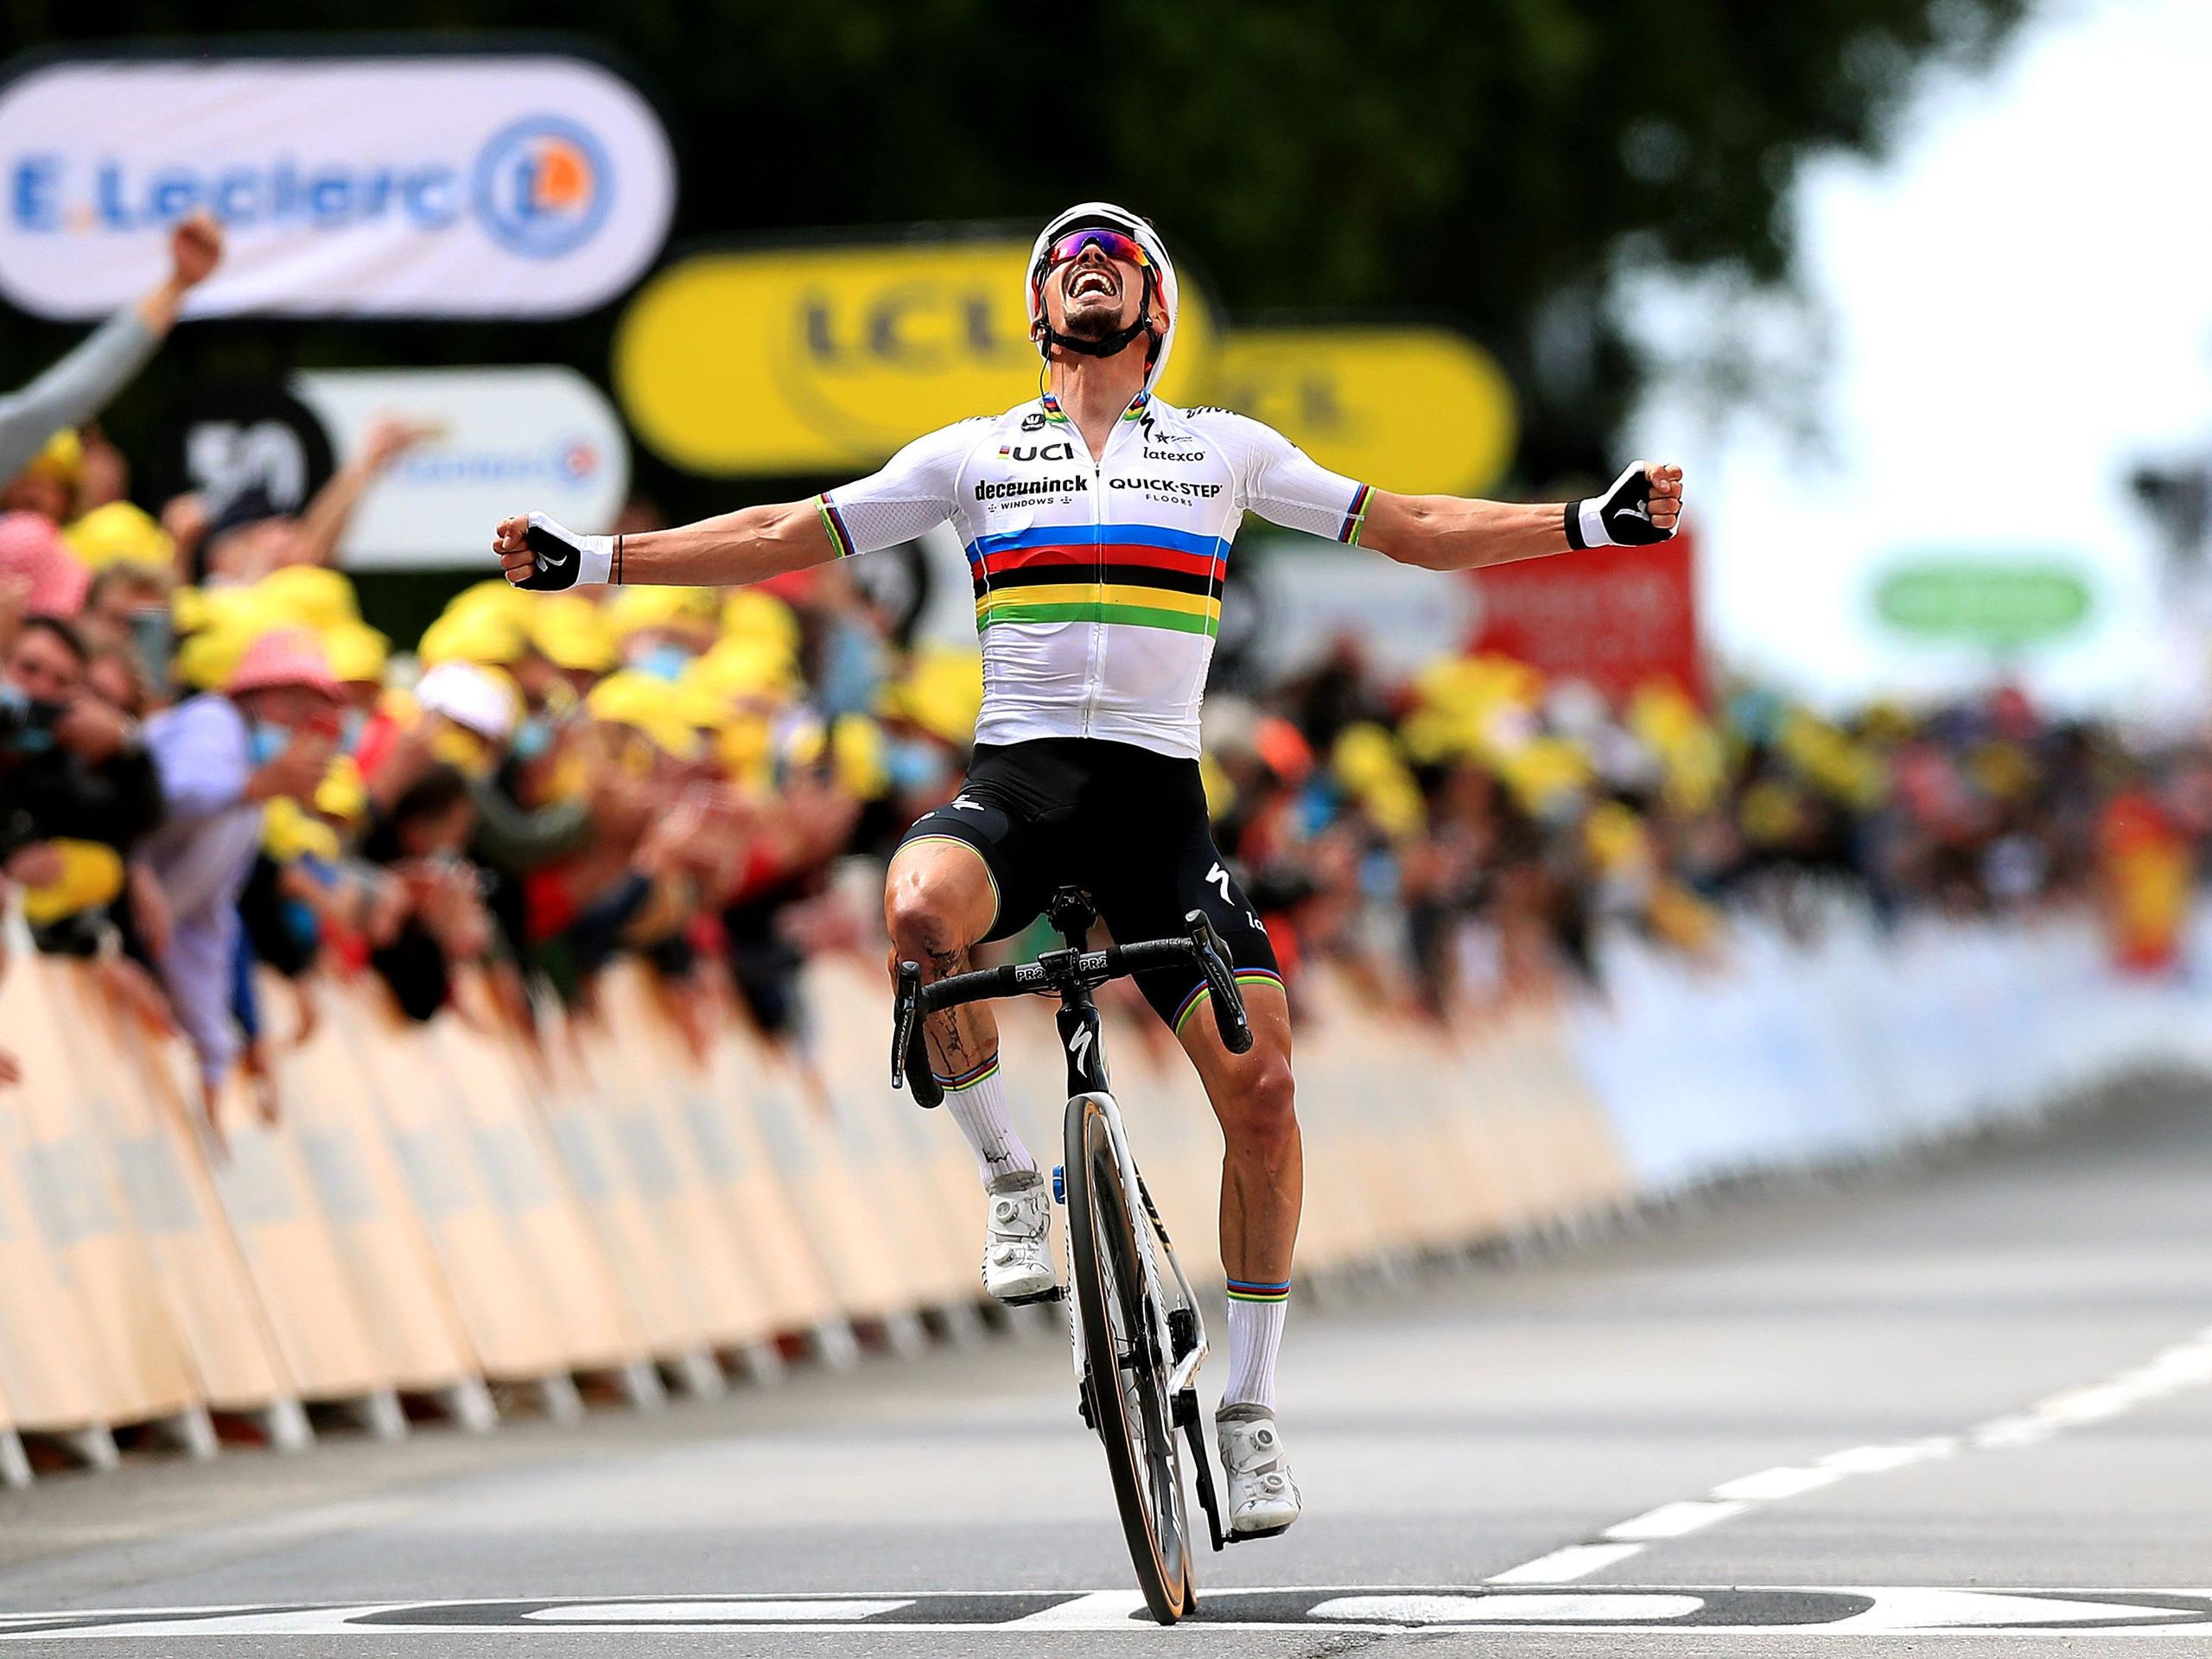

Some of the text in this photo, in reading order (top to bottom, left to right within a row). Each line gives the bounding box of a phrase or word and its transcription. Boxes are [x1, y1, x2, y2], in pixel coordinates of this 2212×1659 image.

[11, 154, 460, 232] E.Leclerc
[802, 287, 1033, 366] LCL
[1013, 442, 1074, 461] UCI
[1143, 446, 1204, 461] latexco
[975, 475, 1088, 501] deceuninck
[1001, 497, 1054, 510] WINDOWS
[1146, 494, 1193, 507] FLOORS
